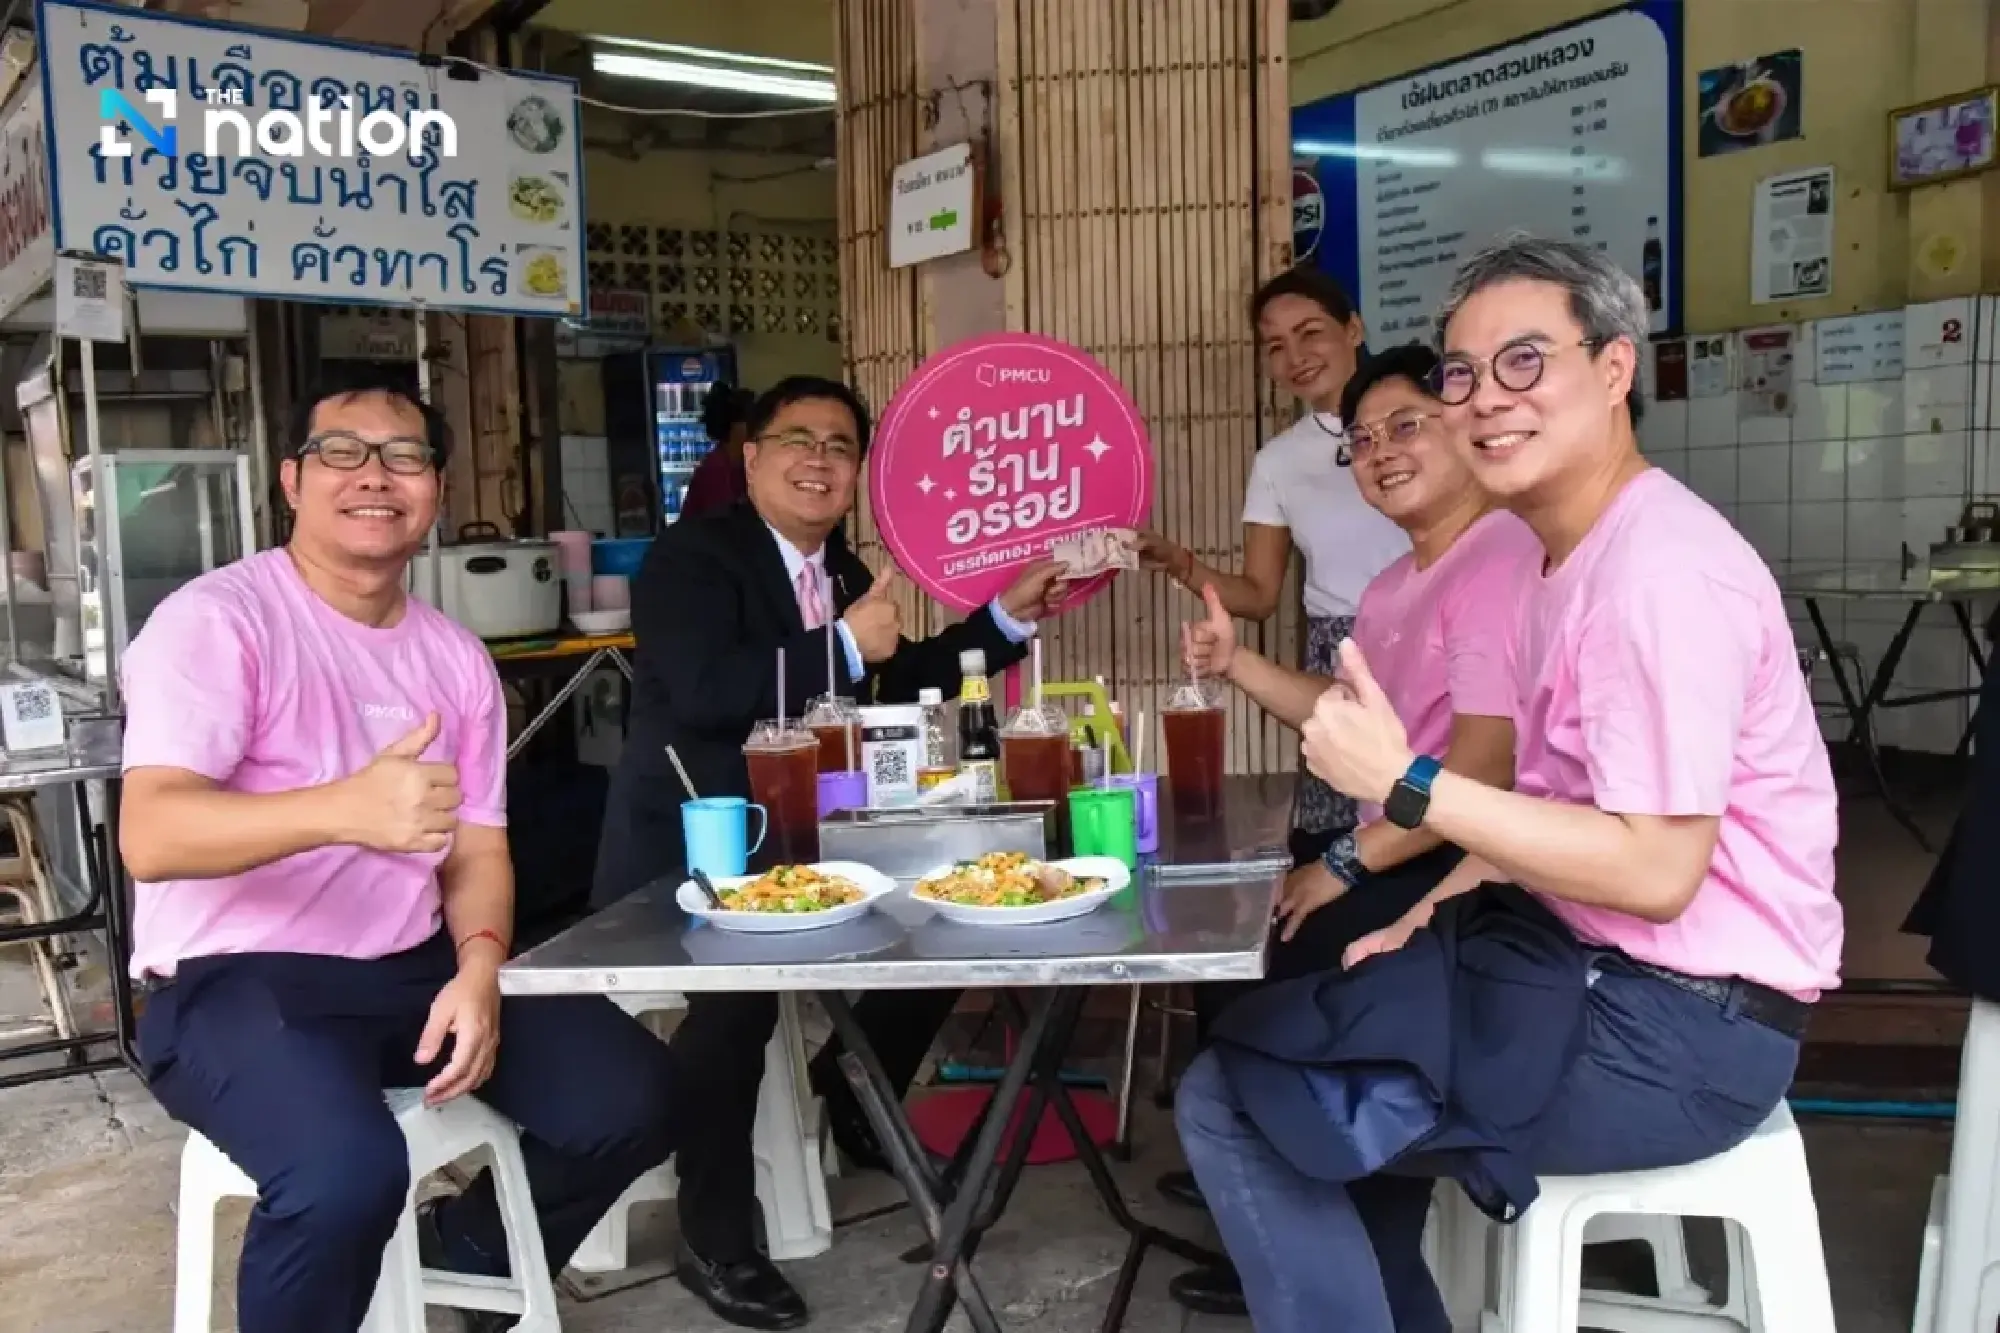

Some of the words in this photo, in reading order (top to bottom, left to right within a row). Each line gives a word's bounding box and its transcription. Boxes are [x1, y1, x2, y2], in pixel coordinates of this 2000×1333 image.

[93, 197, 258, 279] คั่วไก่
[291, 216, 509, 297] คั่วทาโร่
[1942, 318, 1962, 343] 2
[999, 368, 1051, 384] PMCU
[942, 393, 1085, 460] ตำนาน
[968, 442, 1060, 497] ร้าน
[945, 467, 1082, 545] อร่อย
